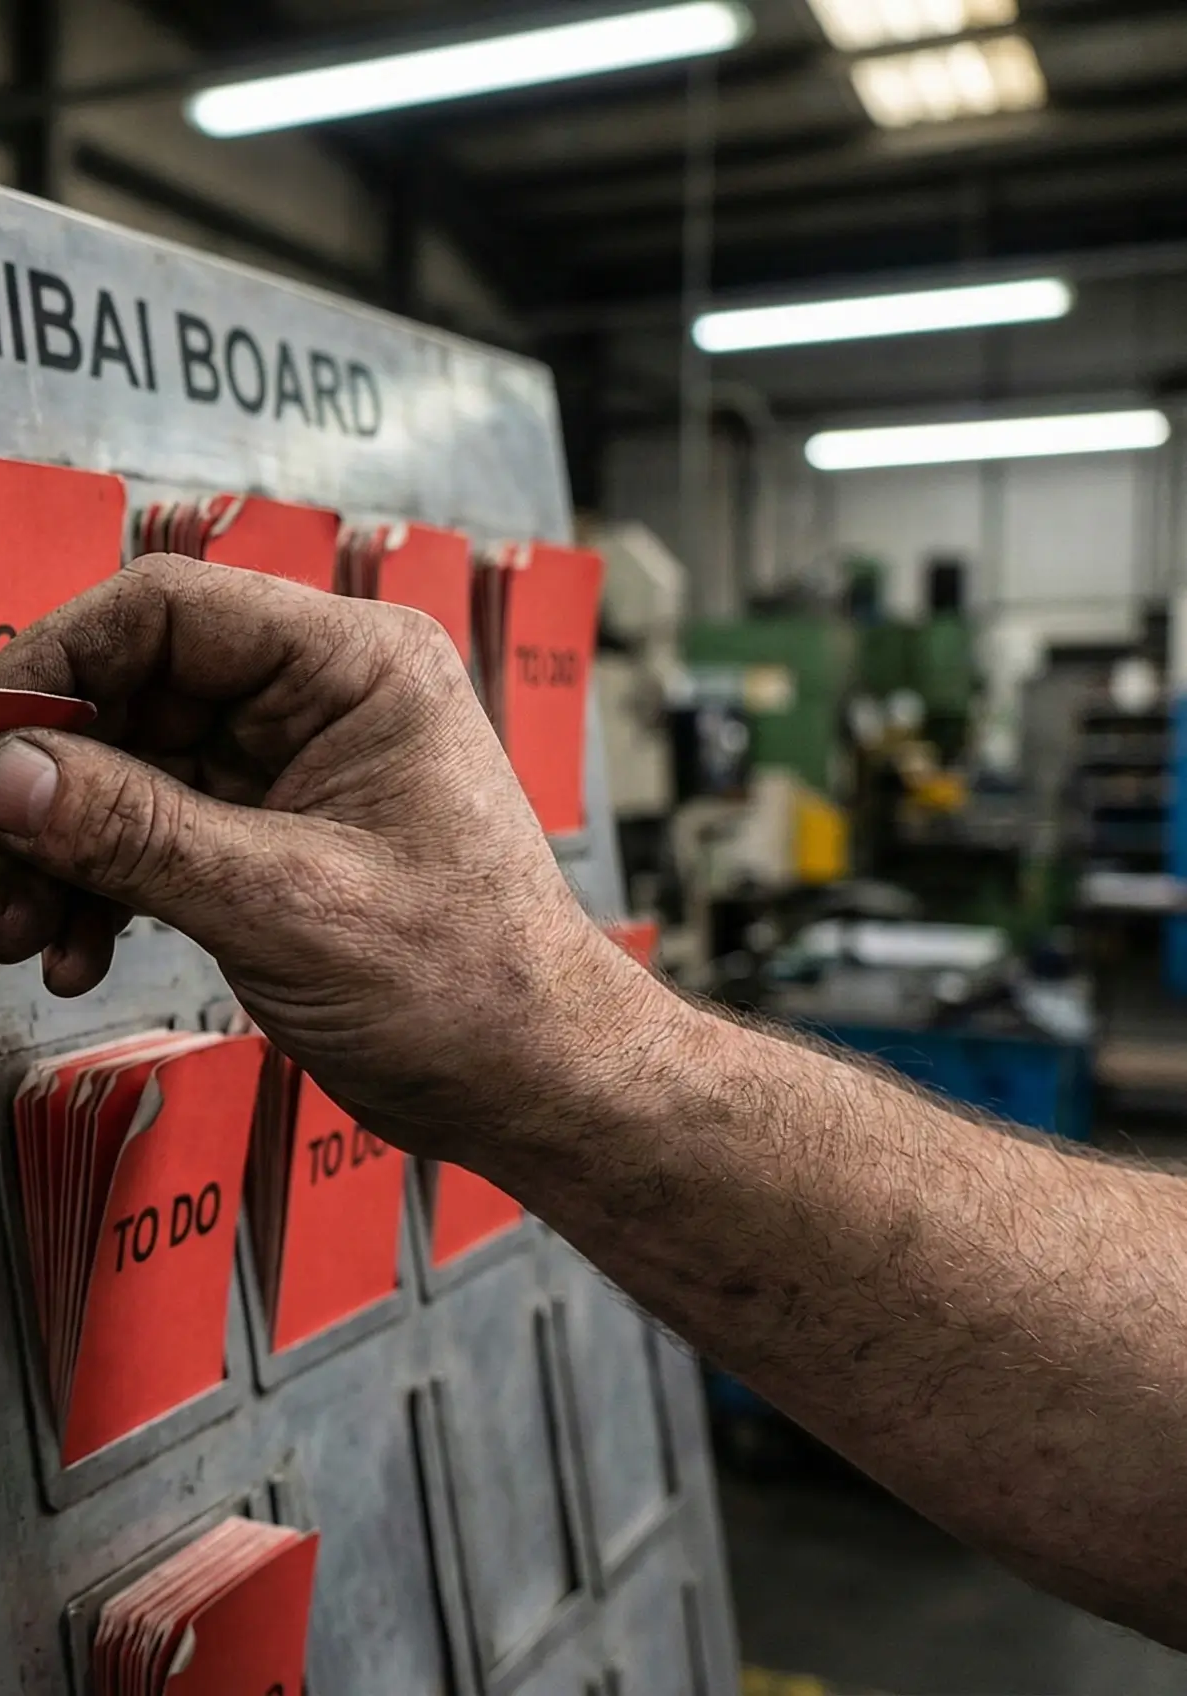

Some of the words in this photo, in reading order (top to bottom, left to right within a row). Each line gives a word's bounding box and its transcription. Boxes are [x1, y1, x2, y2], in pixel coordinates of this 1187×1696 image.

[177, 310, 383, 440] BOARD
[307, 1130, 344, 1187] TO
[114, 1205, 160, 1274] TO
[169, 1180, 222, 1249] DO
